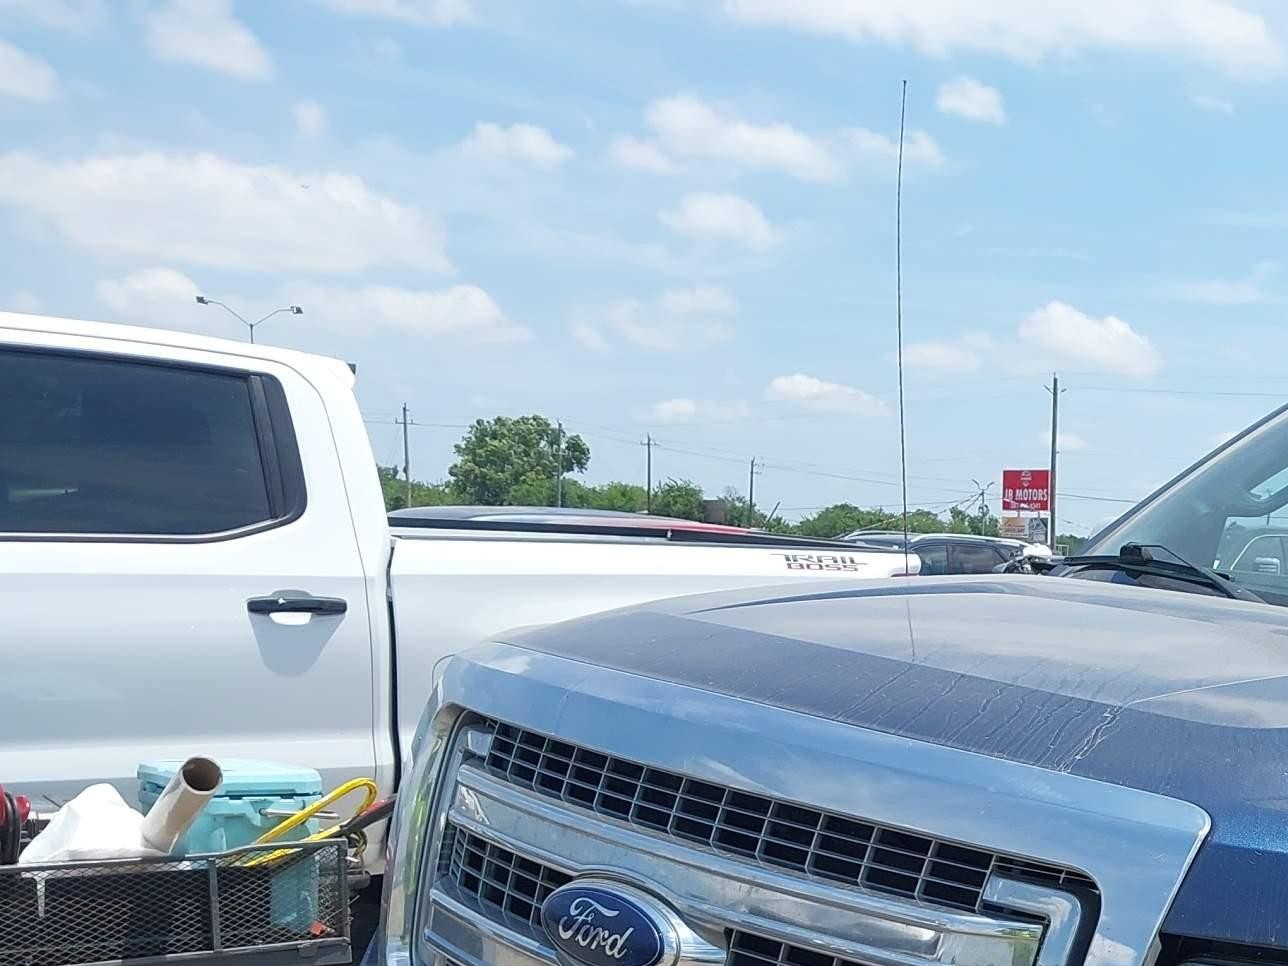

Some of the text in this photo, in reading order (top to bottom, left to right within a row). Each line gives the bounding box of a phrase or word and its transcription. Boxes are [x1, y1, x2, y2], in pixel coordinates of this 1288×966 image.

[1004, 489, 1047, 501] JB MOTORS
[775, 553, 865, 565] TRAIL
[786, 563, 858, 571] BOSS
[558, 897, 634, 959] Ford
